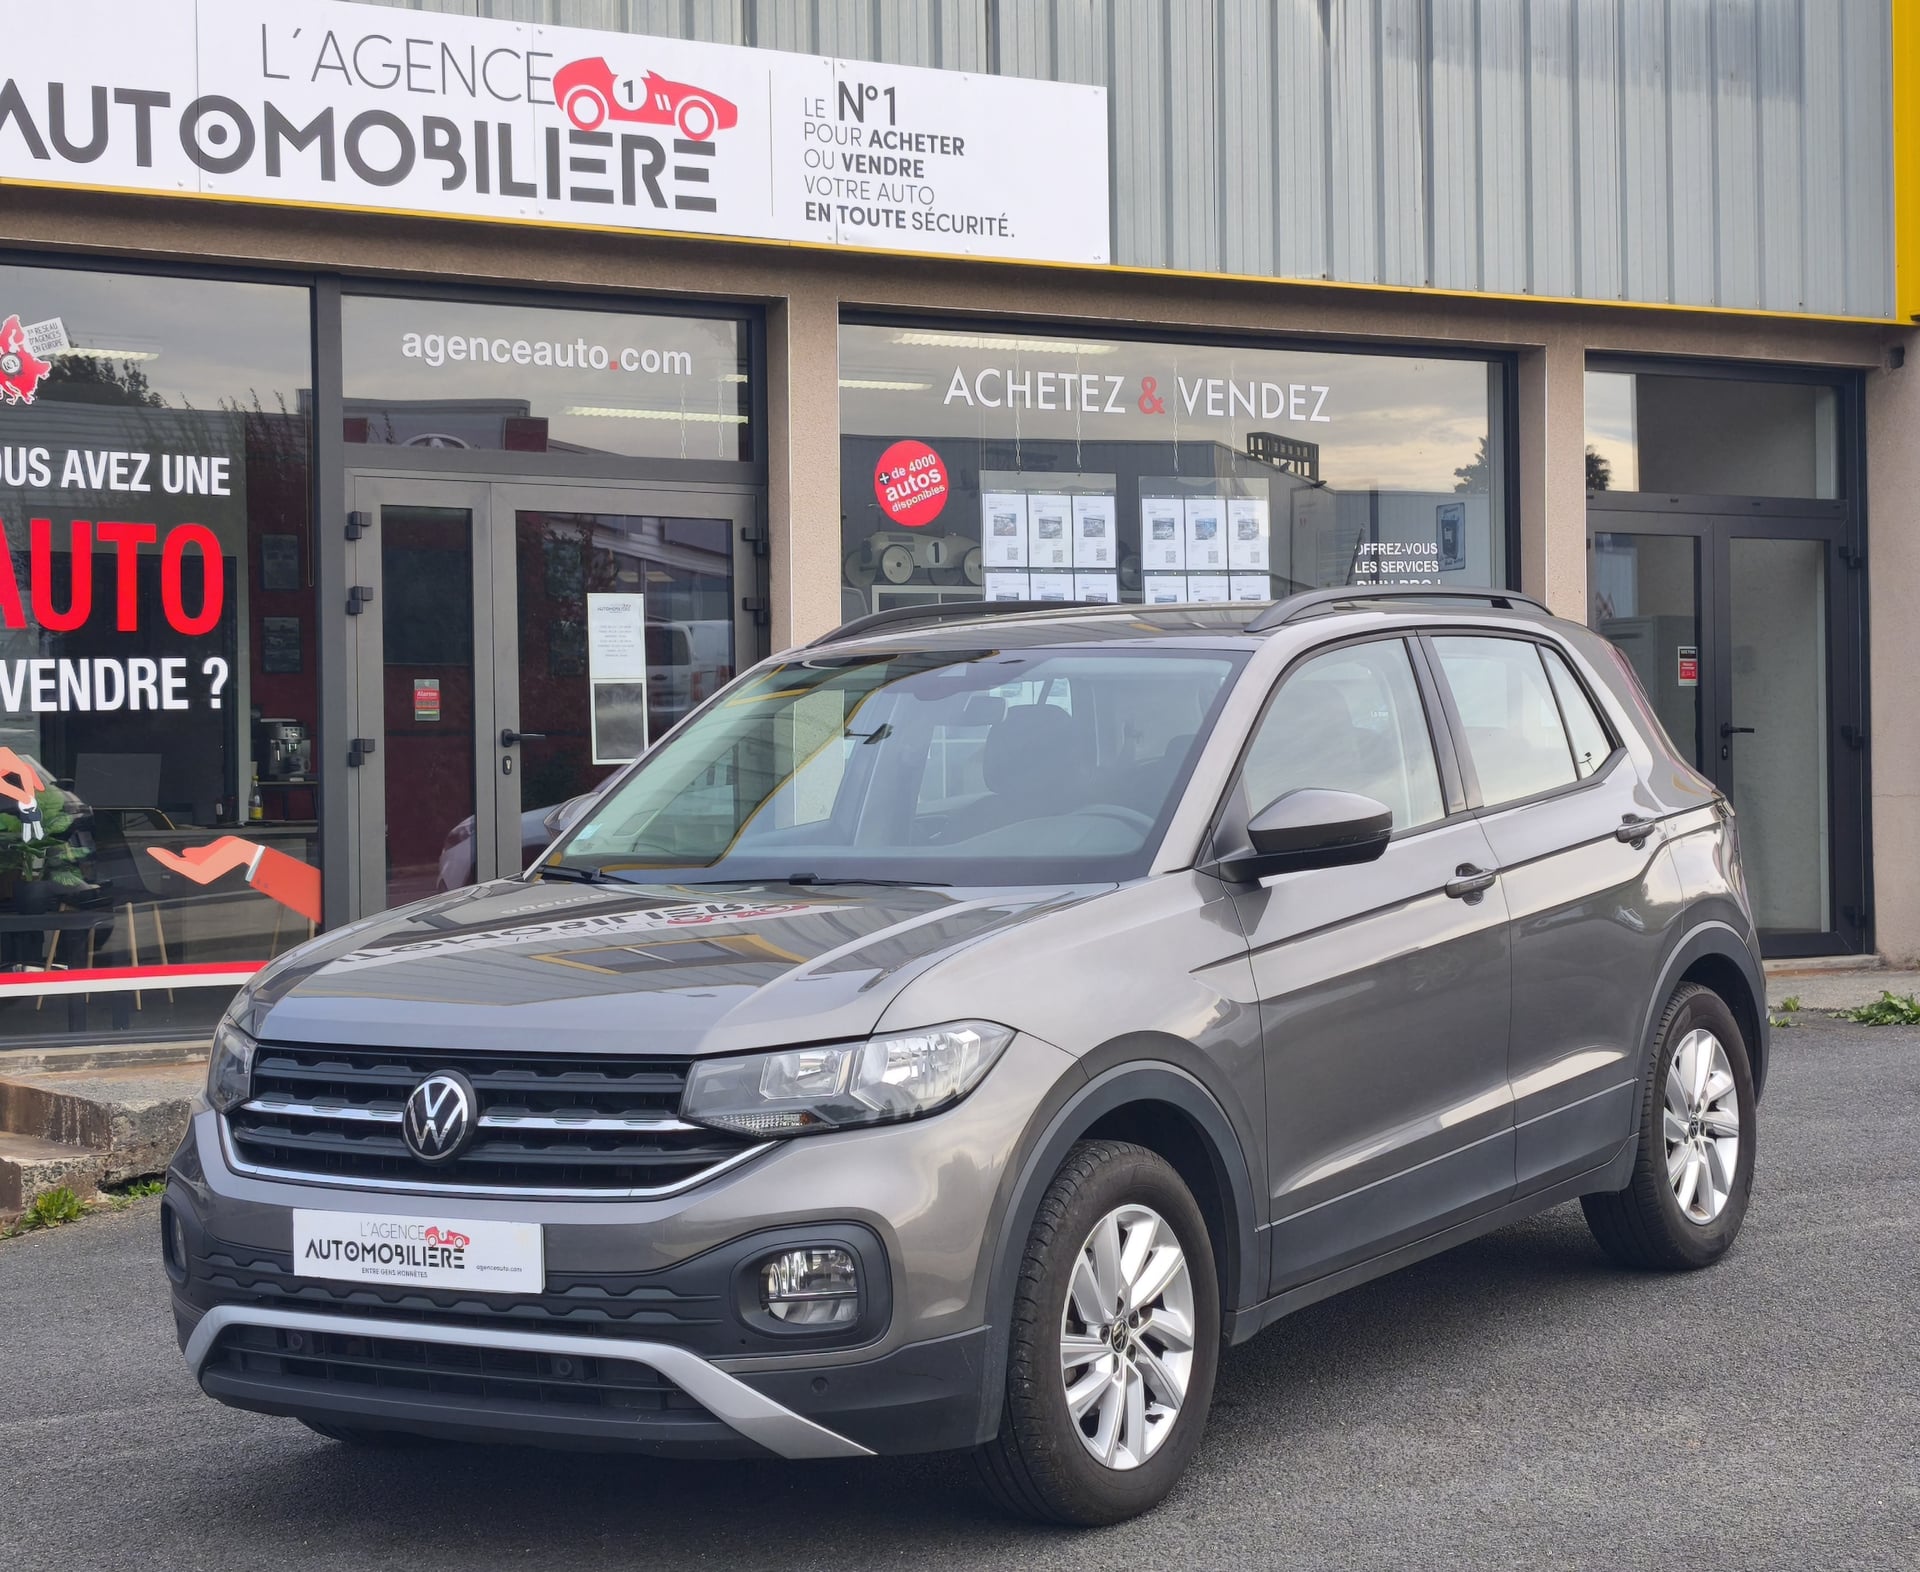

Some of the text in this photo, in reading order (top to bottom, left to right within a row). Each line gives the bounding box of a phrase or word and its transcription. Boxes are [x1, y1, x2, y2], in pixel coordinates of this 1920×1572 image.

[262, 24, 555, 106] L'AGENCE
[623, 80, 633, 103] 1
[804, 97, 826, 119] LE
[804, 122, 965, 156] POUR ACHETER
[803, 149, 925, 179] OU VENDRE
[804, 175, 935, 206] VOTRE AUTO
[805, 202, 1016, 239] EN TOUTE SÉCURITÉ.
[401, 333, 692, 376] agenceauto.com
[943, 366, 1331, 423] ACHETEZ & VENDEZ
[60, 450, 151, 492] AVEZ
[163, 455, 231, 496] UNE
[891, 467, 906, 480] de
[908, 454, 937, 473] 4000
[885, 468, 942, 502] autos
[892, 485, 946, 512] disponibles
[1355, 561, 1378, 574] LES
[1380, 560, 1439, 573] SERVICES
[0, 659, 189, 711] VENDRE
[360, 1221, 425, 1241] L'AGENCE
